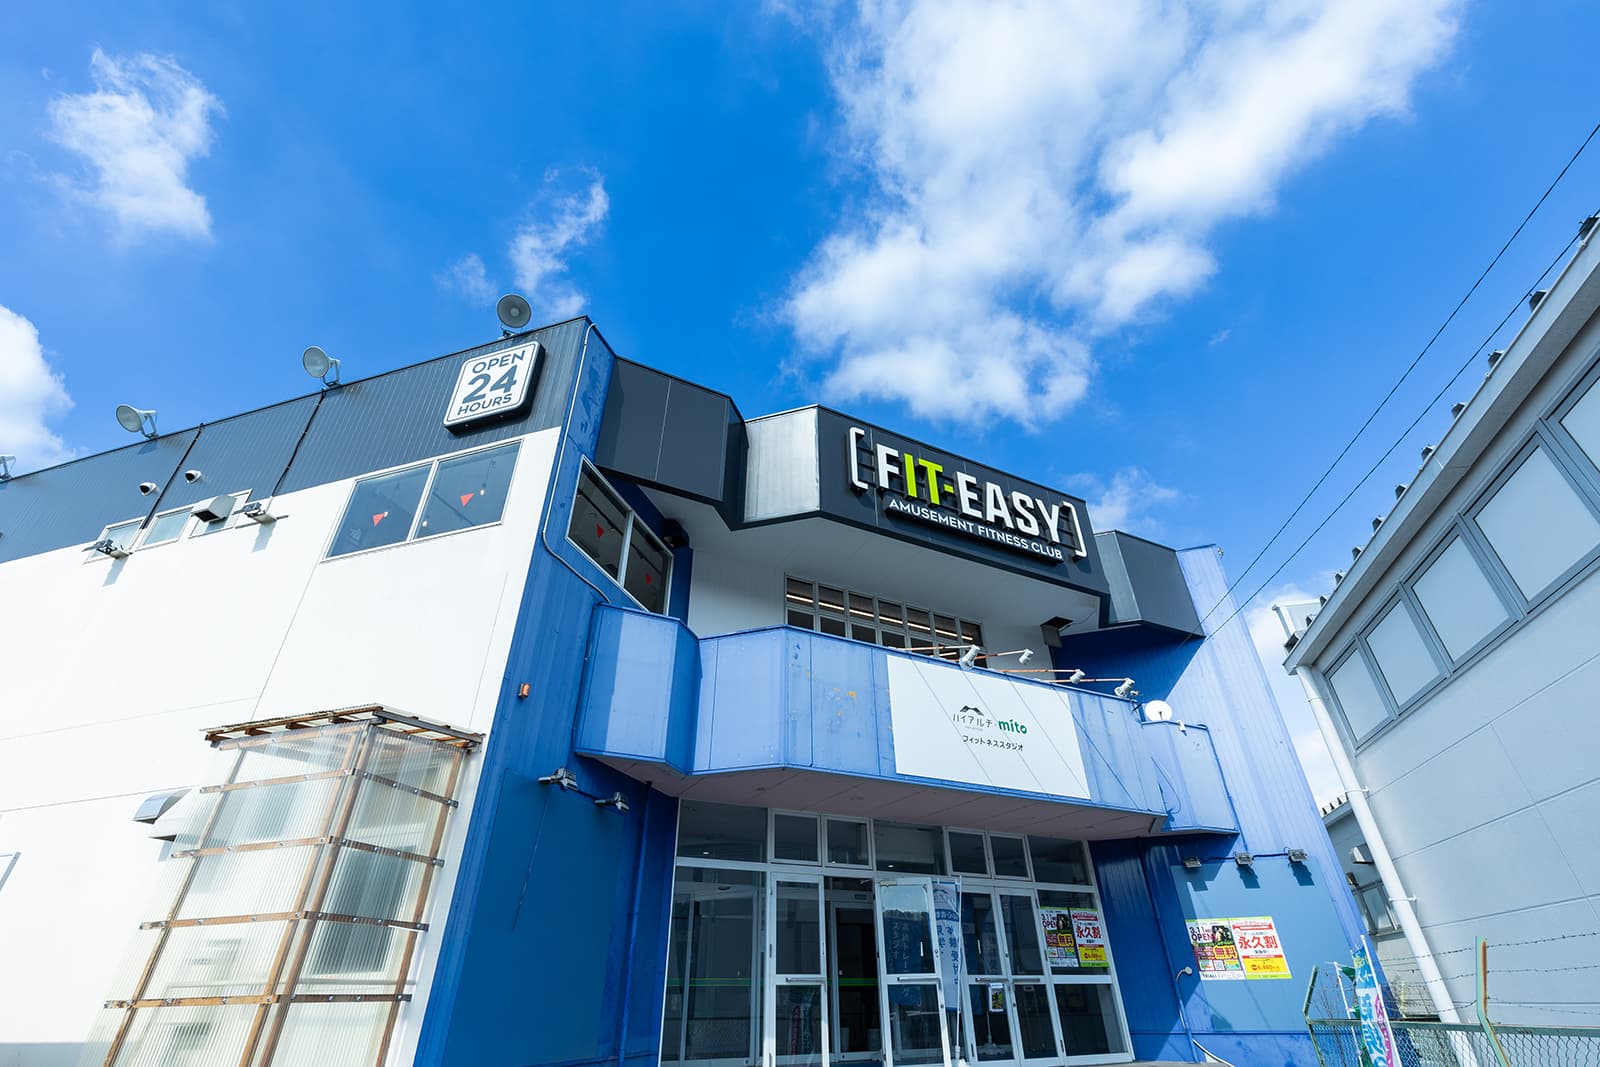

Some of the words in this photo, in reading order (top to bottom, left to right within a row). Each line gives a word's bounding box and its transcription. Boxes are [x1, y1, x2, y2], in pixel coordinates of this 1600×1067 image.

[472, 350, 525, 373] OPEN
[461, 365, 518, 404] 24
[457, 394, 512, 415] HOURS
[889, 499, 975, 532] AMUSEMENT
[978, 525, 1029, 549] FITNESS
[1032, 542, 1063, 560] CLUB
[953, 714, 992, 728] ハイアルチ
[998, 719, 1027, 734] mito
[963, 735, 1023, 751] フィットネススタジオ
[1077, 925, 1102, 939] 永久割
[1238, 935, 1279, 949] 永久割
